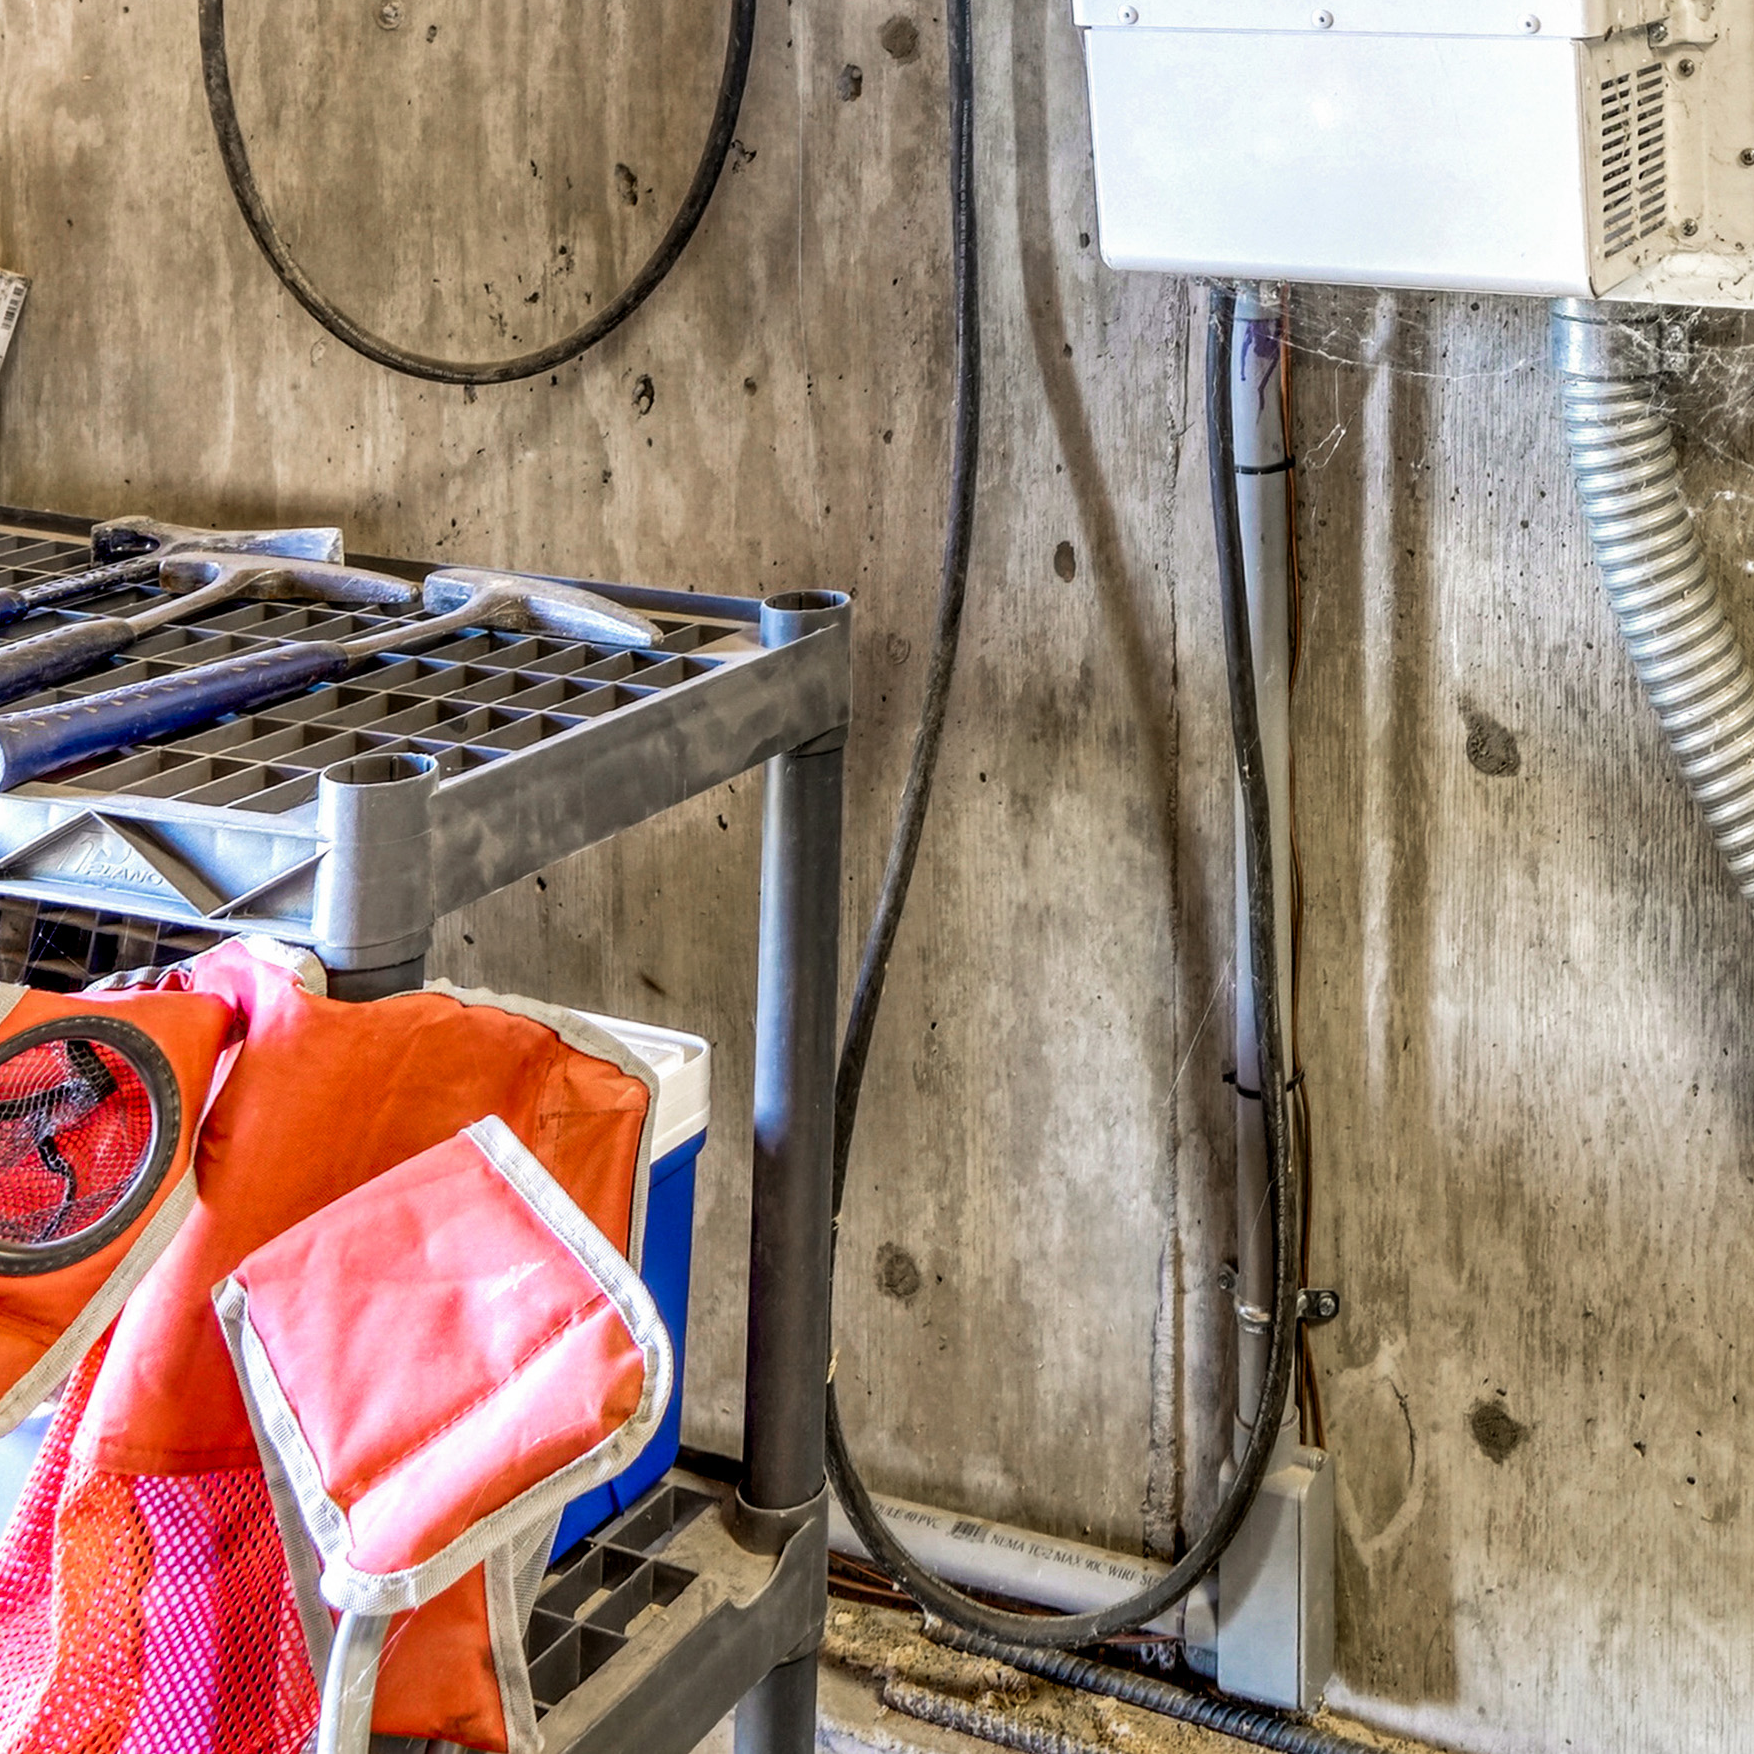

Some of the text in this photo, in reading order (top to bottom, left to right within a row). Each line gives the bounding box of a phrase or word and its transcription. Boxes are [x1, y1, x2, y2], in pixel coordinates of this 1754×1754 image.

[86, 864, 163, 886] PLANO
[916, 1512, 943, 1530] PVC
[990, 1534, 1025, 1552] NEMA
[1054, 1550, 1084, 1567] MAX
[1108, 1565, 1136, 1582] WIRE
